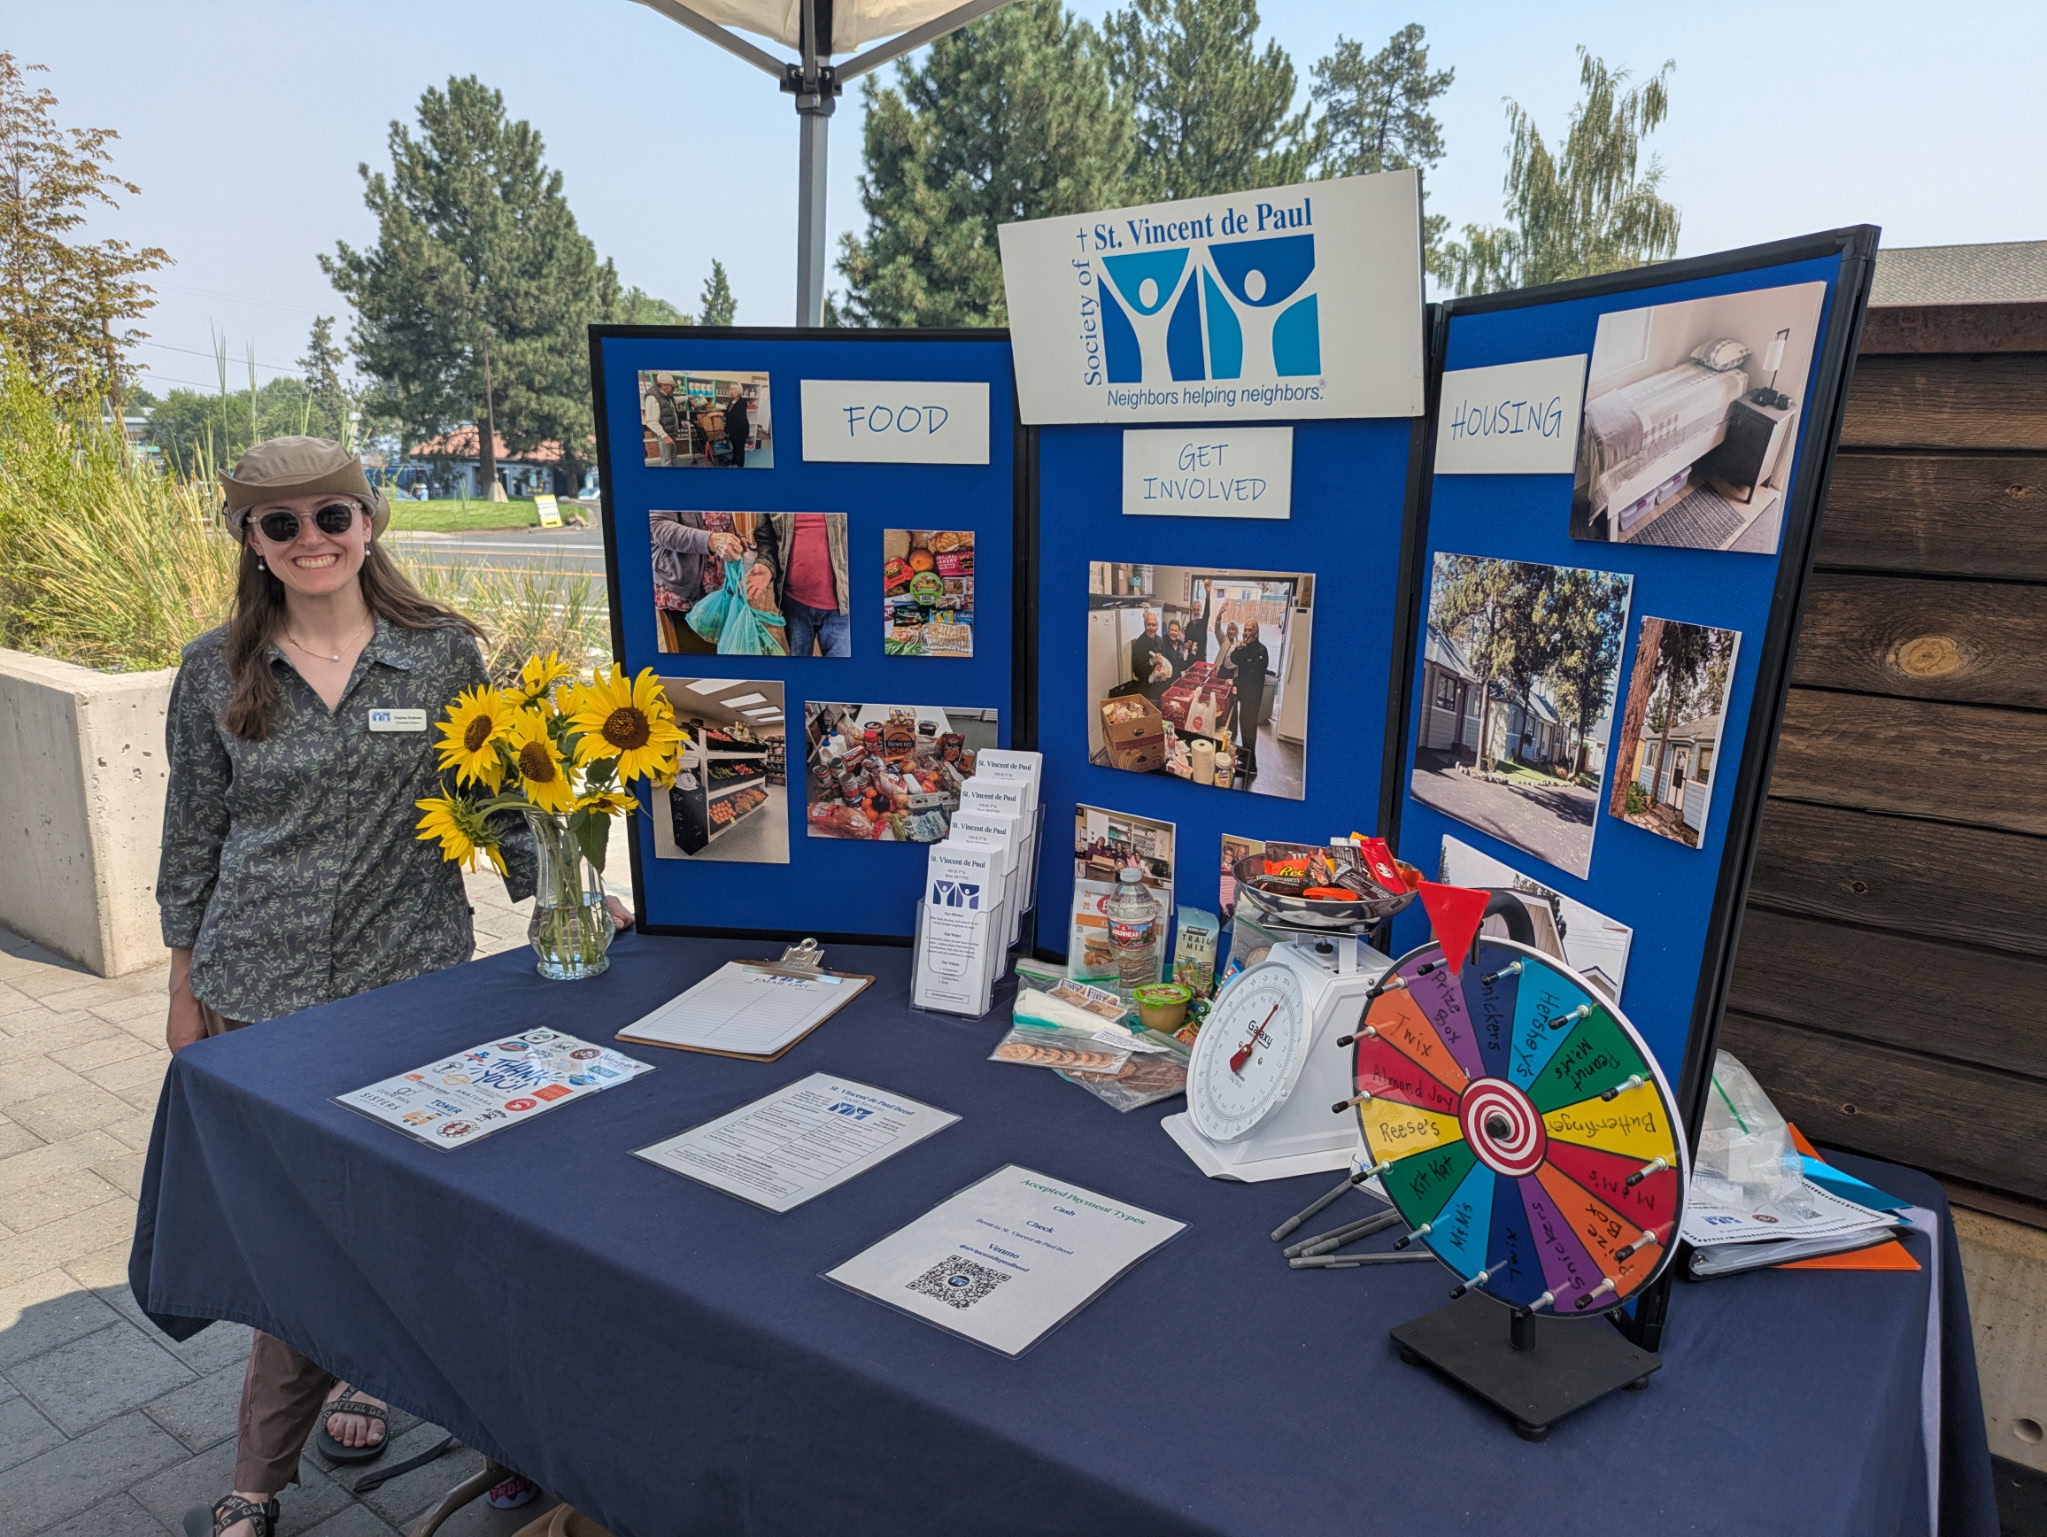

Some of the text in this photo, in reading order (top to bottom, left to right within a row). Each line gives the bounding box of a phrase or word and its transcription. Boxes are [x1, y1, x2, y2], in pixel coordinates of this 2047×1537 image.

[1093, 198, 1313, 251] St. Vincent de Paul
[1072, 258, 1102, 387] Society of
[1107, 388, 1179, 410] Neighbors
[1182, 386, 1236, 408] helping
[842, 405, 950, 437] FOOD
[1450, 396, 1564, 442] HOUSING
[1178, 443, 1230, 472] GET
[1142, 477, 1267, 502] INVOLVED
[987, 761, 1009, 769] Vincent
[971, 791, 994, 800] Vincent
[995, 793, 1002, 801] de
[1003, 794, 1017, 802] Paul
[960, 822, 984, 831] Vincent
[984, 825, 992, 833] de
[993, 827, 1007, 835] Paul
[939, 856, 962, 866] Vincent
[963, 859, 971, 867] de
[972, 860, 985, 868] Paul
[1182, 933, 1211, 945] TRAIL
[1186, 943, 1204, 952] MIX
[1433, 1009, 1461, 1044] Box
[1481, 977, 1505, 1051] nickers
[1389, 1011, 1433, 1057] Twix
[490, 1058, 548, 1087] THANK
[359, 1092, 402, 1111] SISTERS
[1372, 1064, 1454, 1112] Almond Joy
[430, 1099, 463, 1115] TOWER
[1380, 1118, 1441, 1144] Reese's
[1546, 1111, 1657, 1139] Butterfinger
[1409, 1154, 1453, 1201] Kit Kat
[1019, 1178, 1147, 1226] Accepted Payment Types
[1053, 1205, 1076, 1217] Cash
[1025, 1219, 1055, 1235] Check
[1585, 1203, 1623, 1239] Box
[988, 1242, 1020, 1260] Venmo
[1505, 1226, 1522, 1282] Twix
[1532, 1202, 1585, 1290] Snickers
